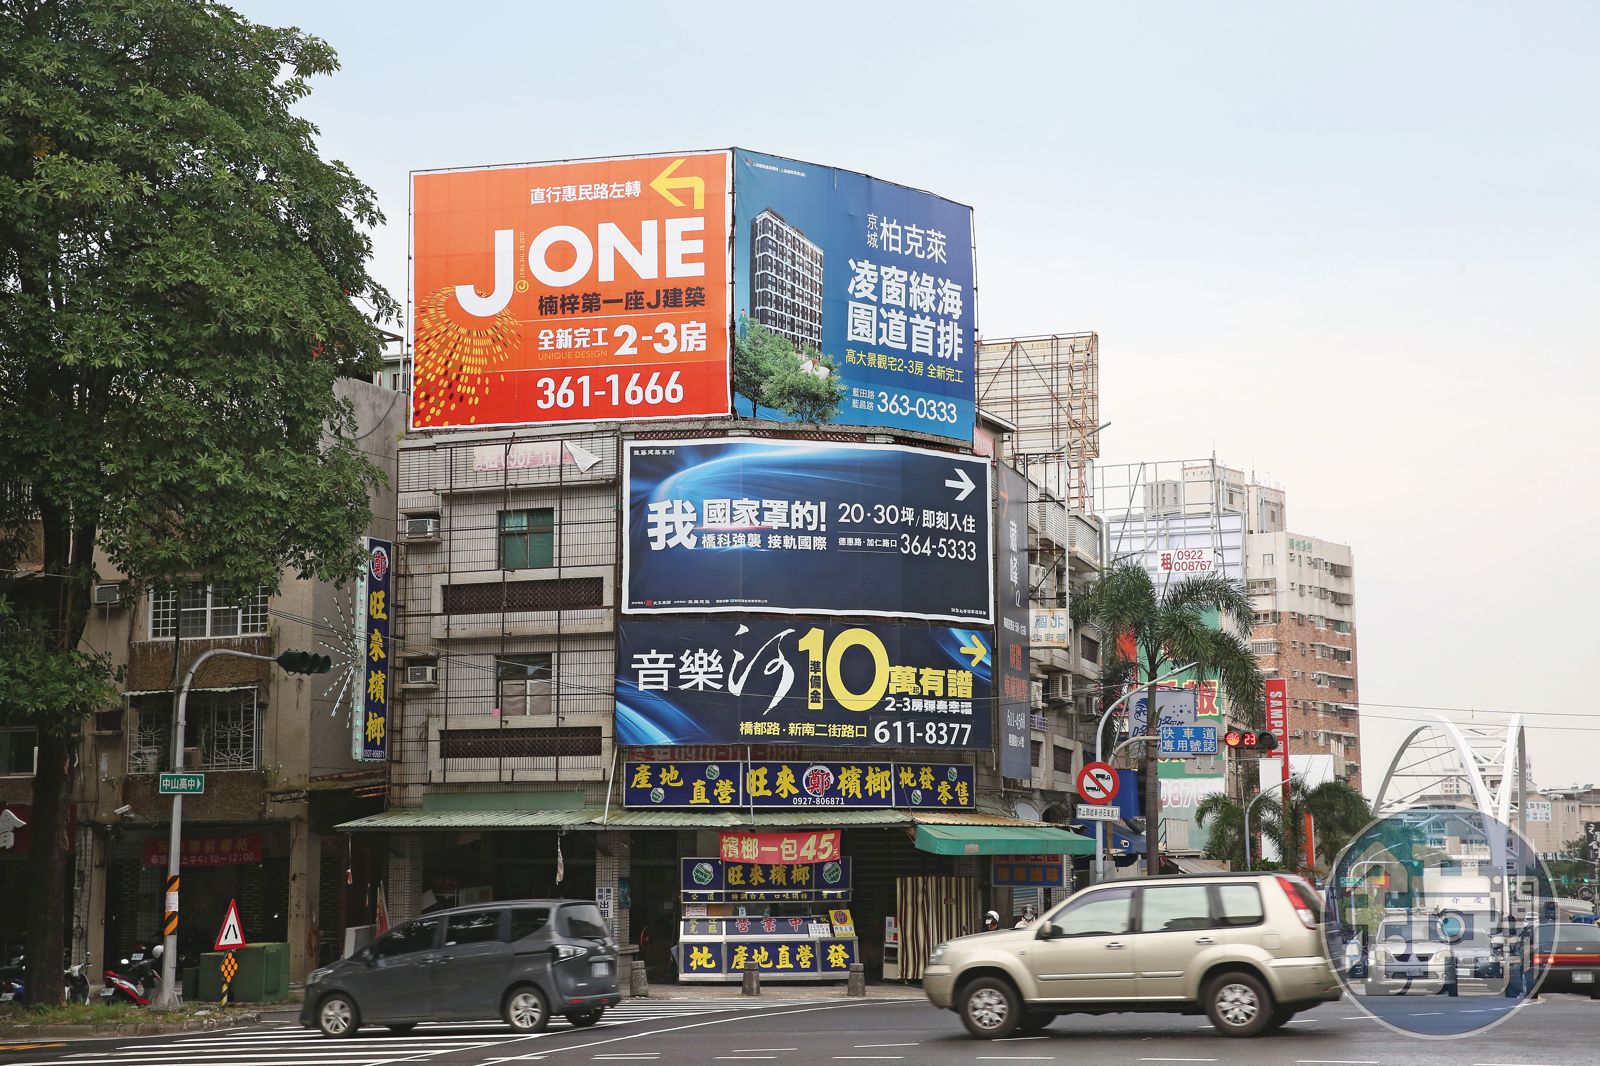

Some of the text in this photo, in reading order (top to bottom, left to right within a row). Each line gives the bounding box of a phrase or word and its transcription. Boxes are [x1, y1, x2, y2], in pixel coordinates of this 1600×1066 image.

[530, 180, 641, 205] 直行惠民路左轉
[866, 212, 879, 249] 京城
[880, 216, 948, 264] 柏克萊
[538, 286, 706, 316] 楠梓第一座J建築
[847, 258, 963, 320] 凌窗綠海
[537, 320, 707, 356] 全新完工 2-3房
[846, 300, 963, 362] 園道首排
[537, 350, 608, 361] UNIQUE DESIGN
[845, 348, 964, 383] 高大景觀宅2-3房 全新完工
[536, 370, 684, 409] 361-1666
[877, 391, 957, 424] 363-0333
[702, 497, 826, 532] 國家罩的!
[701, 533, 827, 551] 橋科強襲 接軌國際
[900, 533, 977, 561] 364-5333
[1161, 553, 1172, 570] 租
[1174, 561, 1212, 571] 008767
[1177, 550, 1203, 560] 0922
[365, 590, 388, 746] 旺來檳榔
[810, 660, 821, 703] 準備金
[874, 720, 972, 746] 611-8377
[1163, 727, 1214, 739] 快車道
[1244, 734, 1256, 745] 23
[1163, 740, 1215, 752] 專用號誌
[162, 778, 196, 790] 中山高中
[630, 764, 684, 789] 產地
[837, 765, 892, 799] 檳榔
[899, 765, 935, 790] 批發
[689, 779, 737, 805] 直營
[792, 797, 845, 806] 0927-806871
[937, 780, 970, 806] 零售
[728, 864, 810, 886] 旺來檳榔
[735, 917, 803, 932] 營業中
[690, 946, 716, 970] 批
[731, 944, 815, 969] 產地直營
[826, 943, 850, 968] 發
